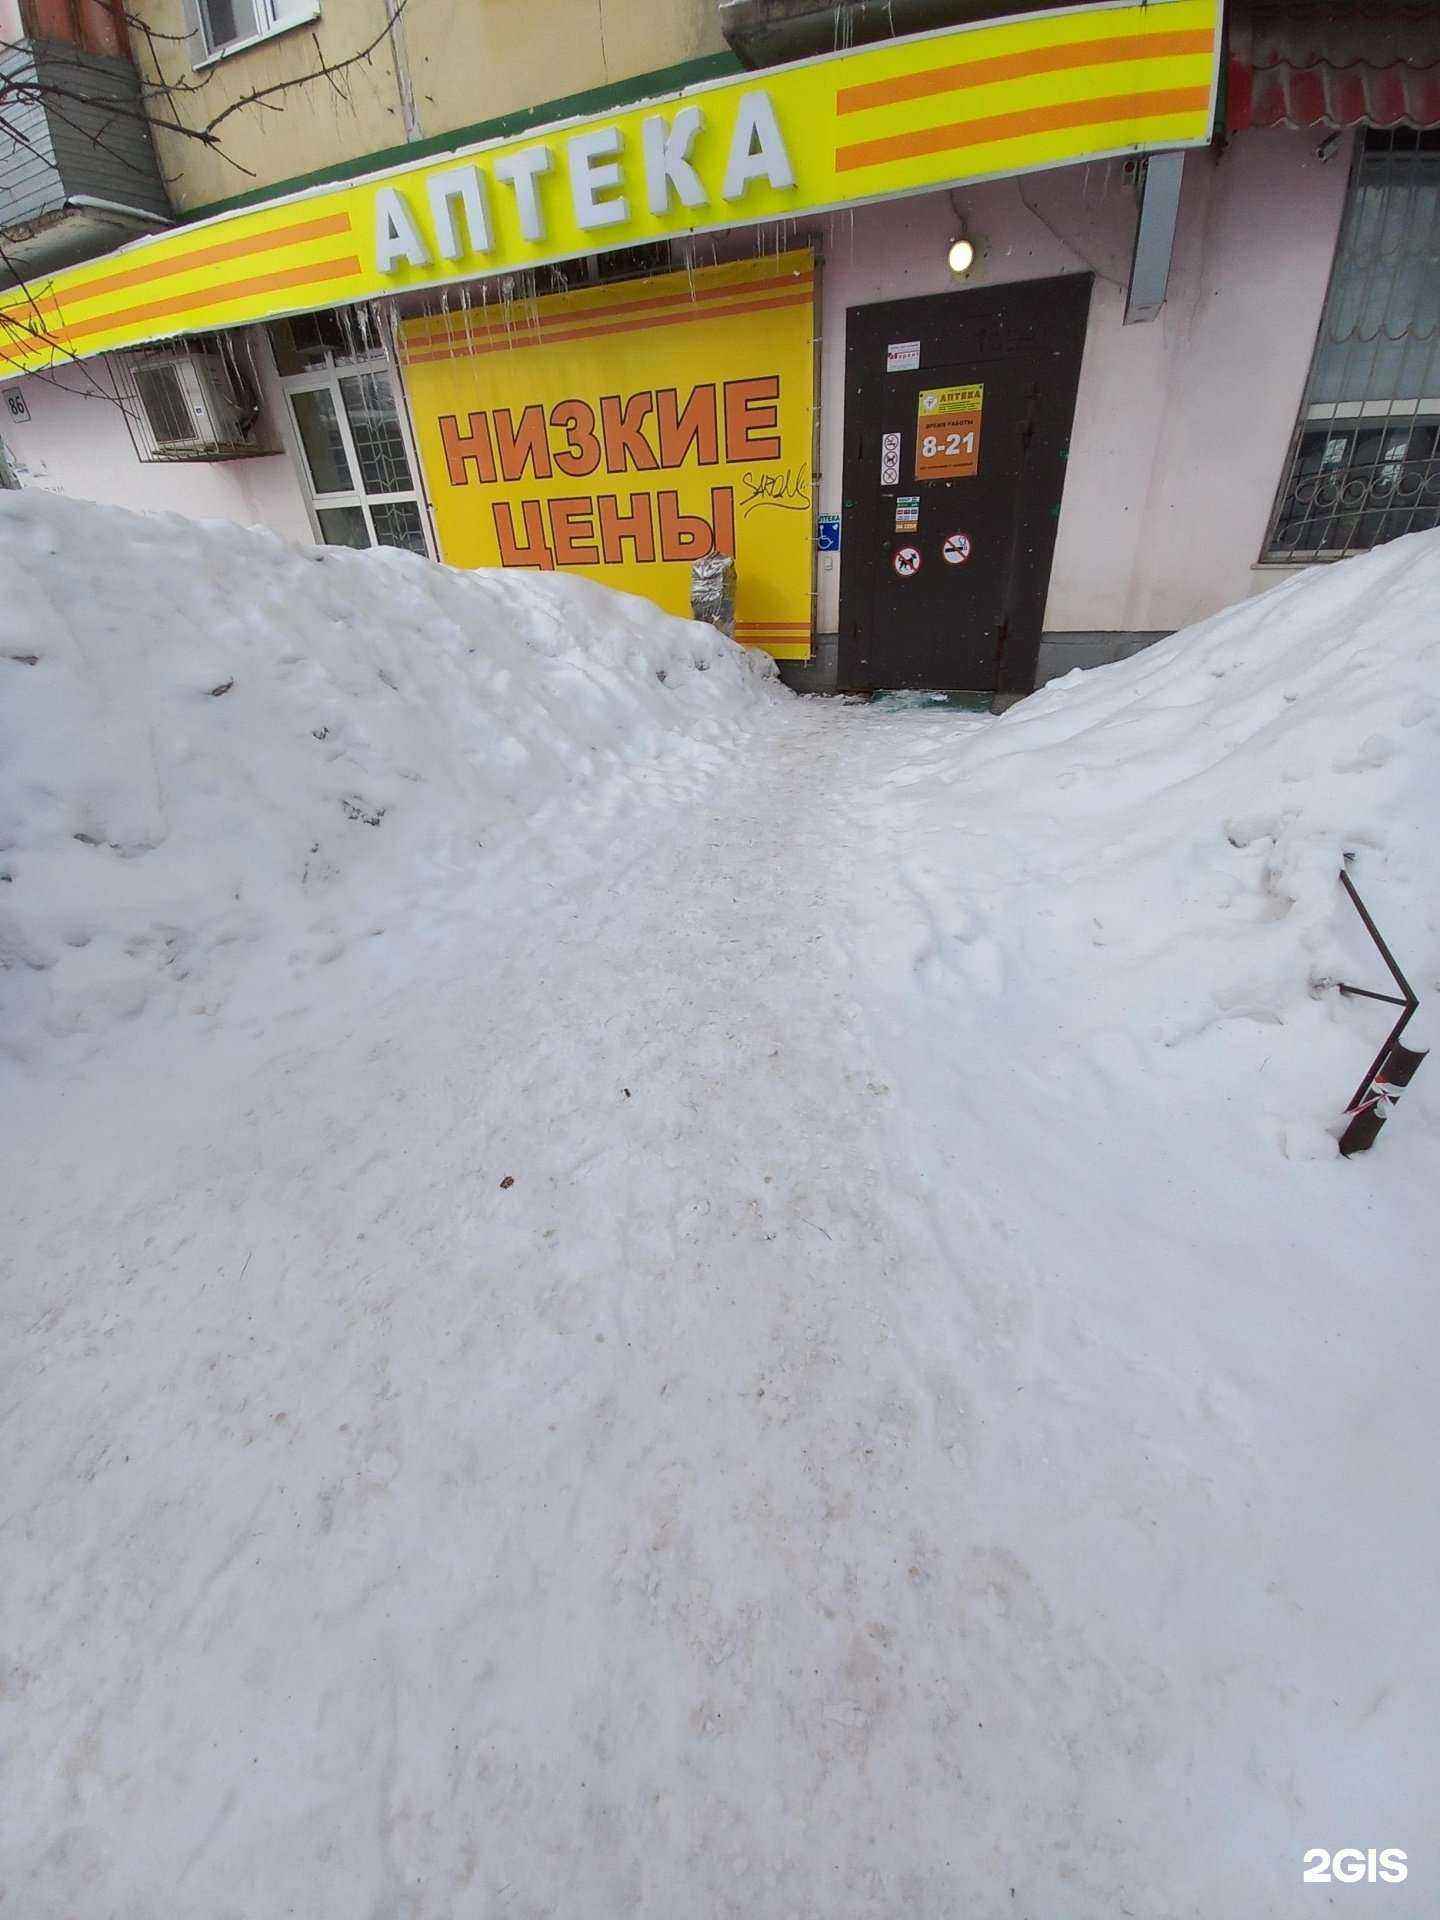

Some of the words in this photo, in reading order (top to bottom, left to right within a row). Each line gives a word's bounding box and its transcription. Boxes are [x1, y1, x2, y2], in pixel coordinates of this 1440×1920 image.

[374, 89, 797, 274] АПТЕКА
[8, 395, 25, 415] 86
[939, 390, 981, 402] АПТЕКА
[438, 374, 781, 487] НИЗКИЕ
[921, 431, 974, 458] 8-21
[491, 486, 736, 572] ЦЕНЫ
[818, 514, 840, 523] ПТЕКА
